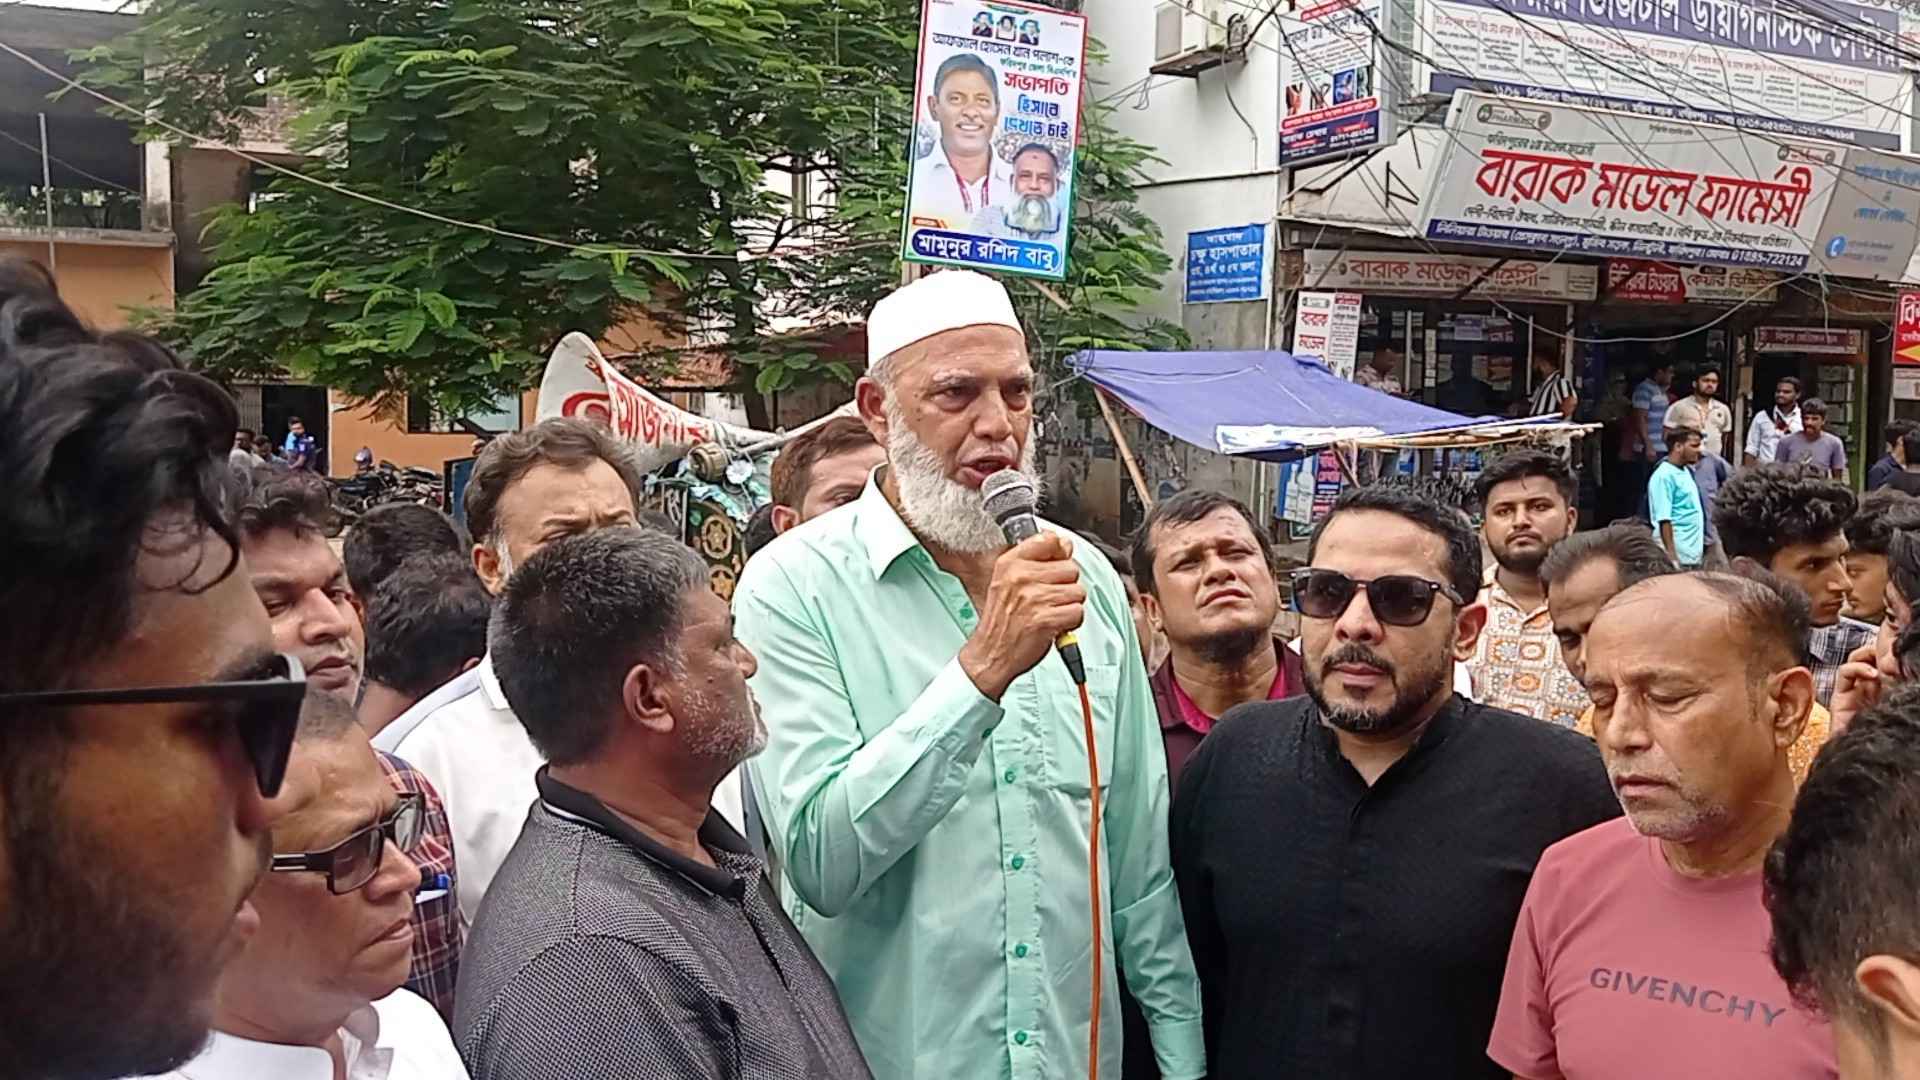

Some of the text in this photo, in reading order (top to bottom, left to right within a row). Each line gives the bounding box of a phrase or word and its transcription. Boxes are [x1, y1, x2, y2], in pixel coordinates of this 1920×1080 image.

[1003, 71, 1072, 96] সভাপতি
[1017, 94, 1060, 117] হিসাবে
[1004, 116, 1069, 140] দেখতে চাই
[1475, 149, 1812, 228] বারাক মডেল ফার্মেসী
[917, 233, 1055, 272] মামুনুর রশিদ বাবু
[1208, 243, 1262, 261] হাসপাতাল
[1349, 259, 1410, 281] বারাক
[1415, 261, 1471, 282] মডেল
[1590, 967, 1786, 1027] GIVENCHY
